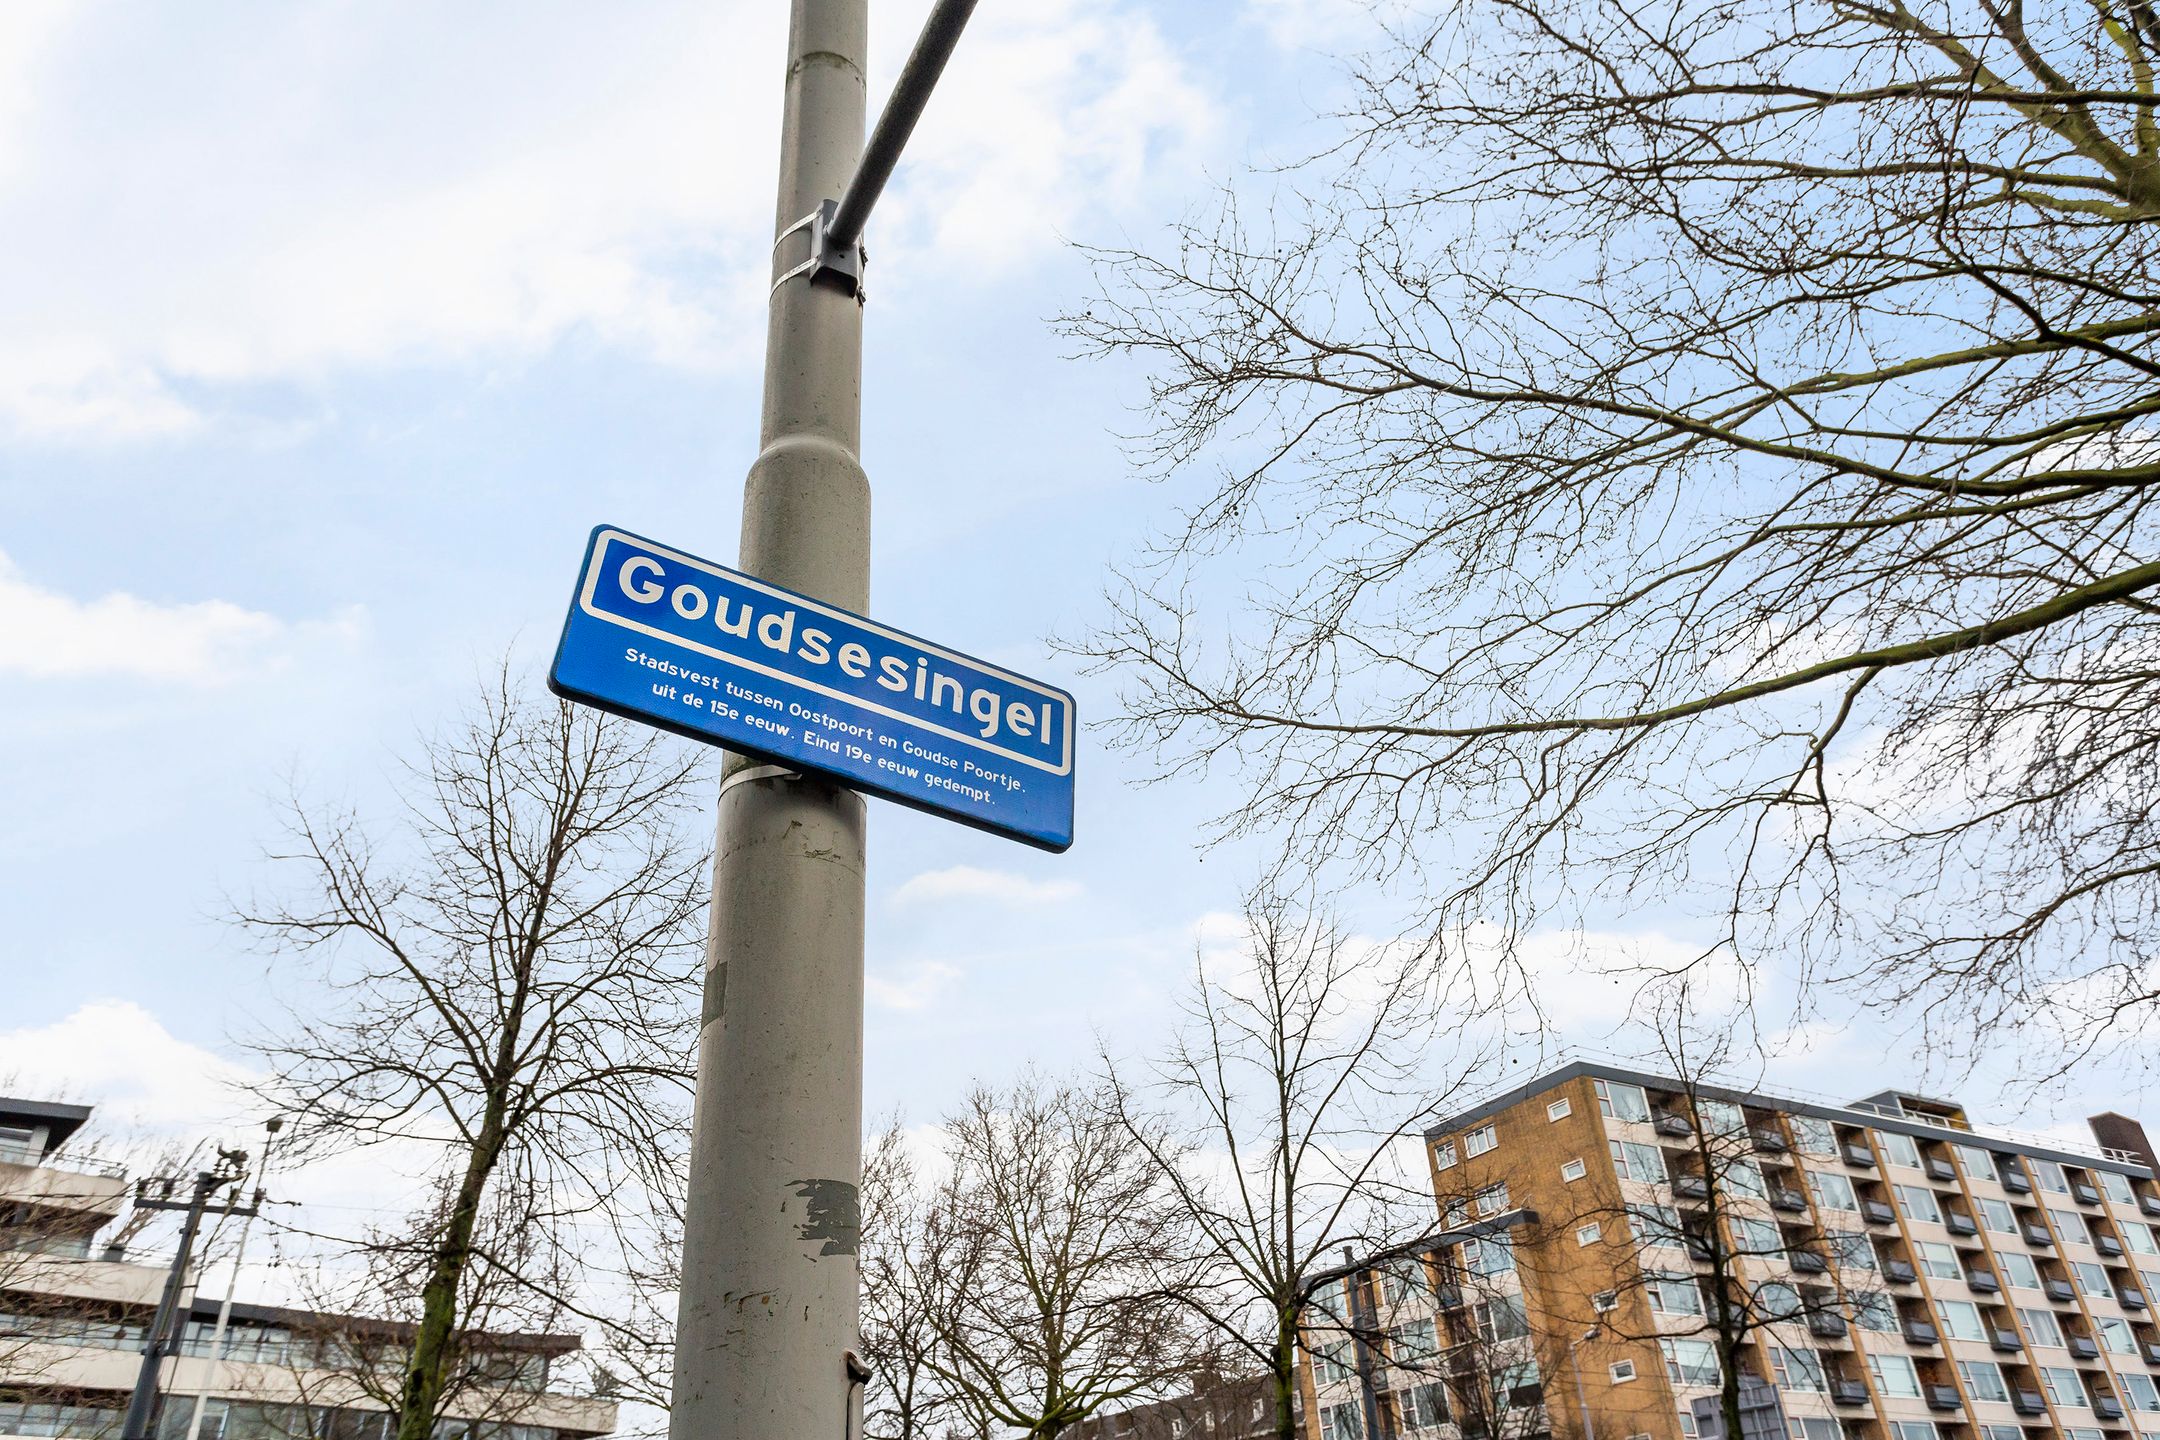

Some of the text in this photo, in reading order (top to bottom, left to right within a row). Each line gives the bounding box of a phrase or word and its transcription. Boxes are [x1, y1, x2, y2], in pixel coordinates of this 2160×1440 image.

[618, 556, 1052, 745] Goudsesingel
[624, 648, 1027, 793] Stadsvest tussen Oostpoort en Goudse Poortje.
[652, 683, 997, 805] uit de 15e eeuw. Eind 19e eeuw gedempt.
